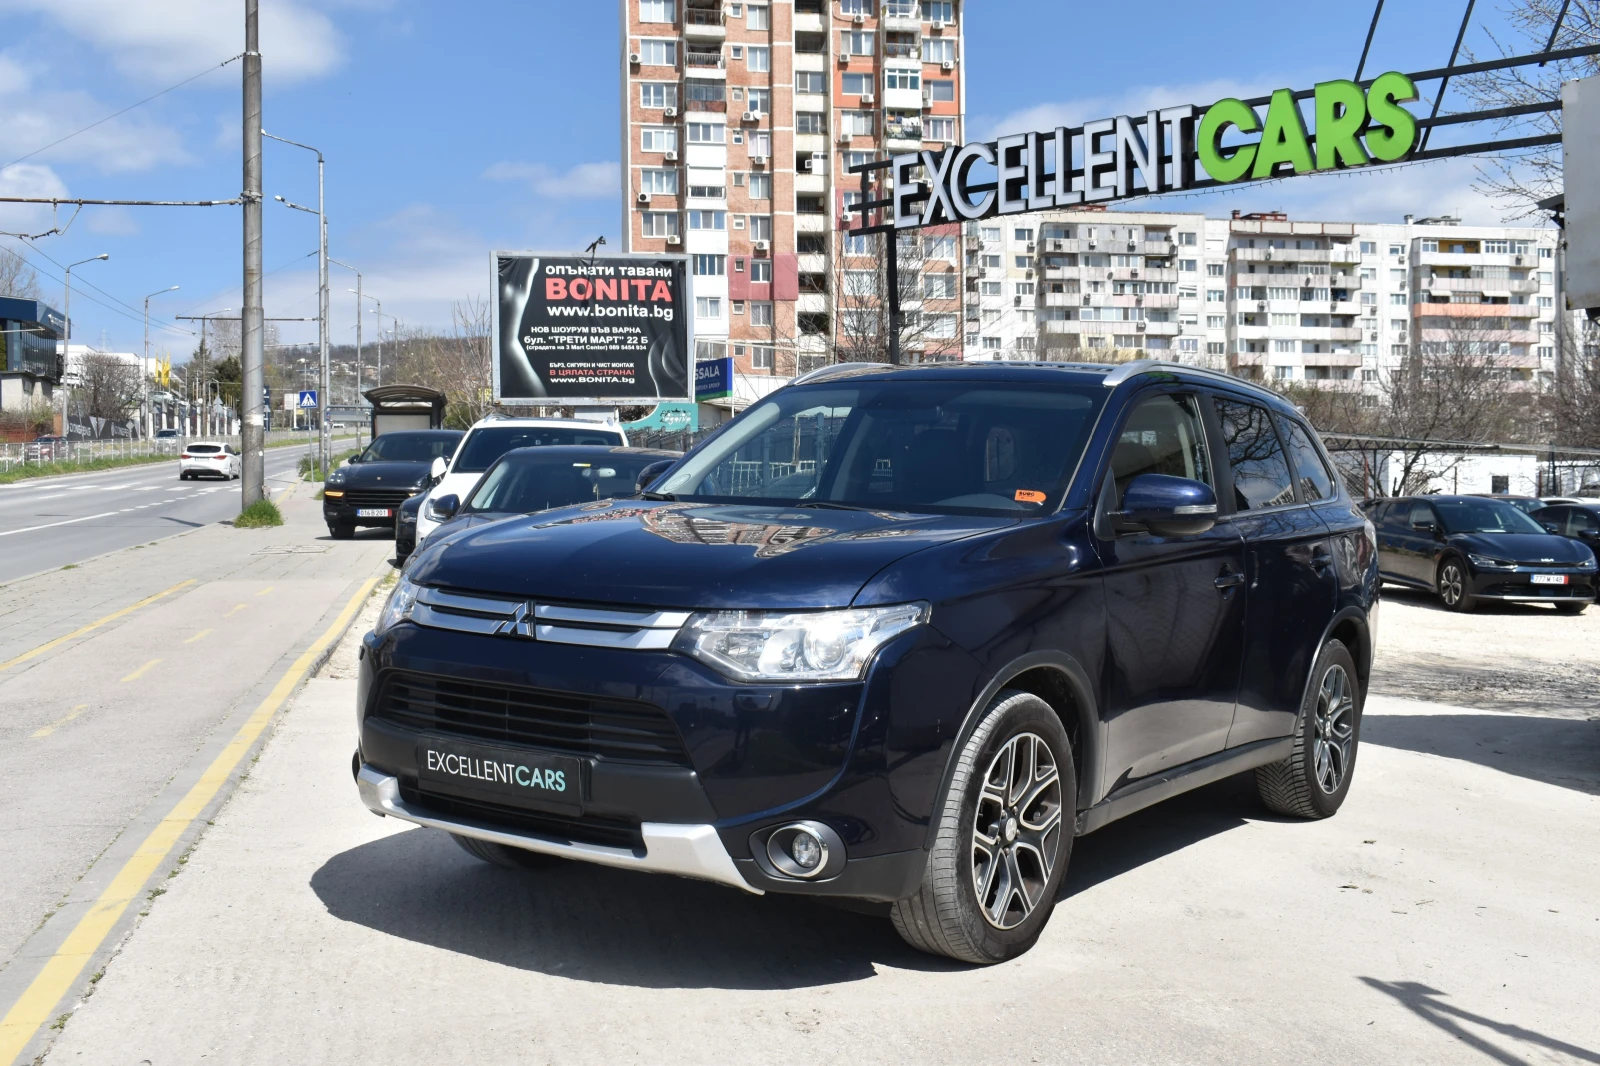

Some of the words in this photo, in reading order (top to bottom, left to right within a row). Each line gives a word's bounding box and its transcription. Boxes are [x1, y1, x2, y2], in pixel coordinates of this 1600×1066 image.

[545, 265, 615, 276] опънати
[618, 266, 673, 278] тавани
[545, 277, 673, 302] BONITA
[546, 304, 674, 321] www.bonita.bg
[530, 326, 550, 334] НОВ
[551, 326, 589, 334] ШОУРУМ
[590, 326, 611, 334] ВЪВ
[612, 326, 642, 334] ВАРНА
[523, 335, 547, 346] бул.
[626, 336, 639, 344] 22
[640, 336, 649, 344] Б
[549, 376, 635, 384] www.BONITA.bg
